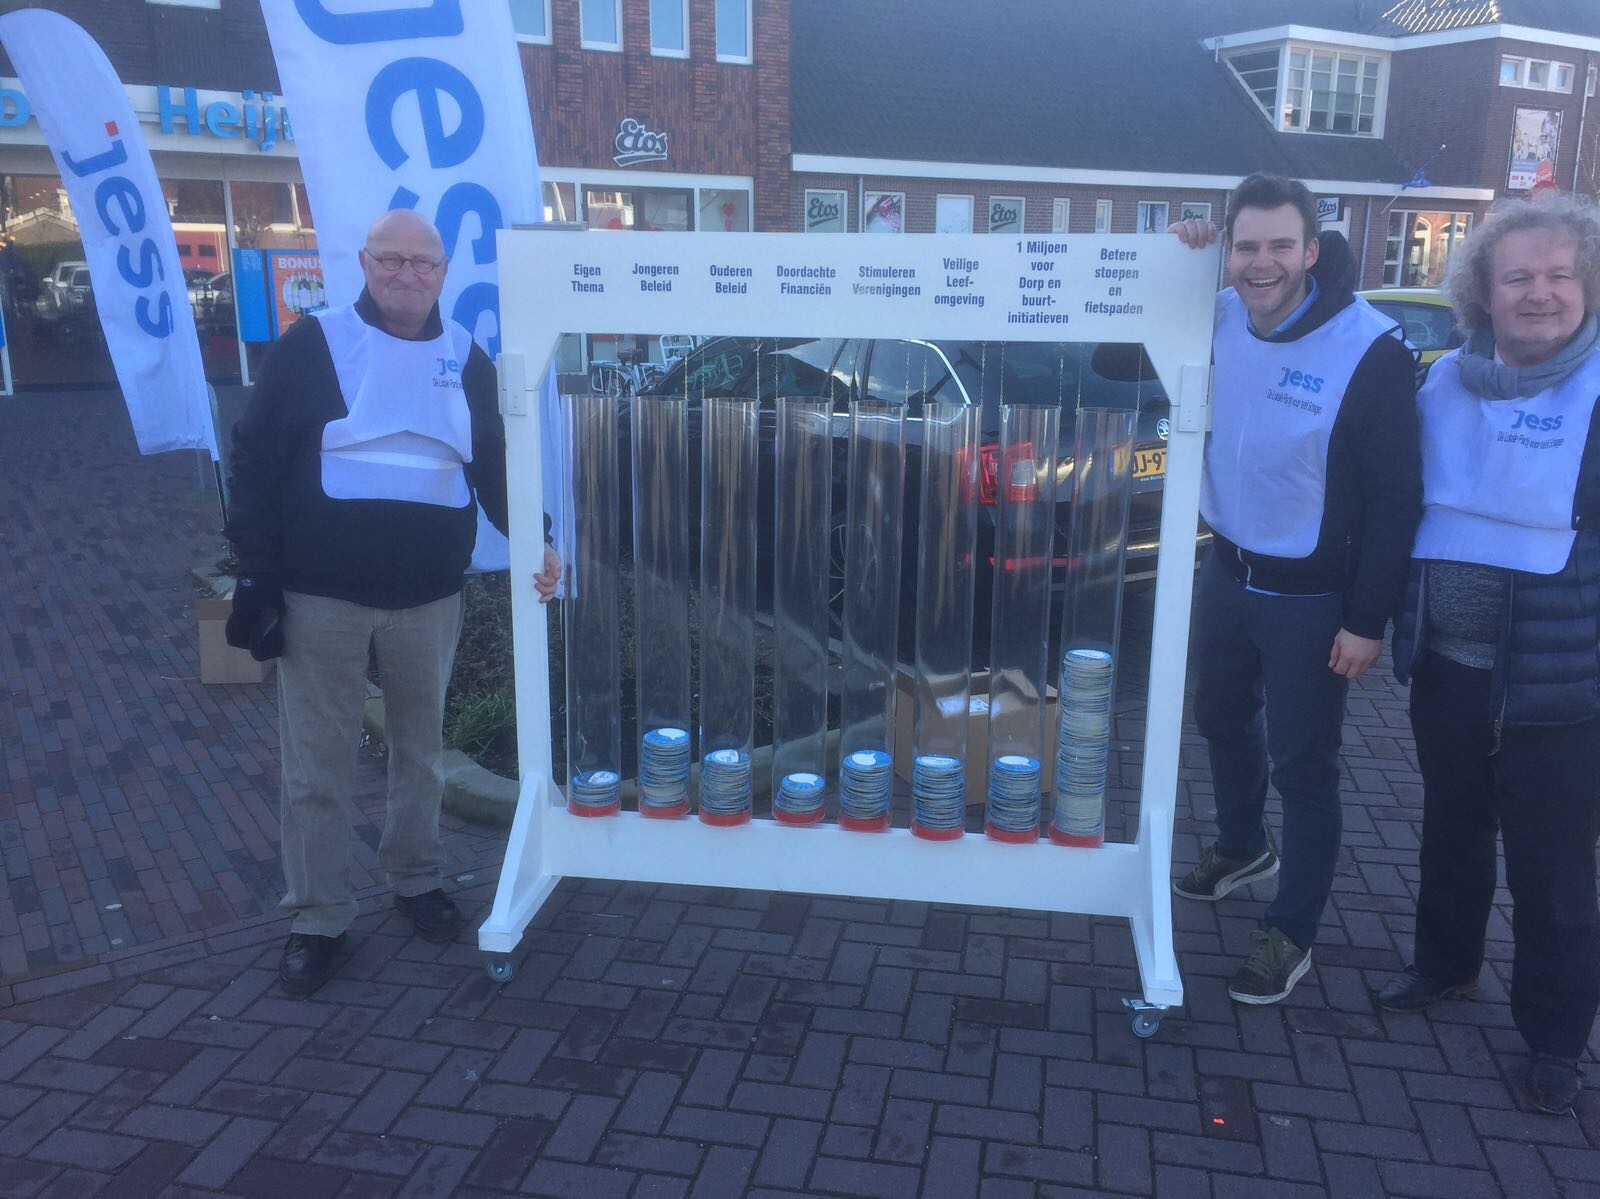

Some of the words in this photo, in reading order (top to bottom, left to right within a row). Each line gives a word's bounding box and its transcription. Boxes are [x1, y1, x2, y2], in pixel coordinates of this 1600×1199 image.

[613, 117, 668, 168] Etos
[807, 197, 840, 228] Etos
[1317, 200, 1337, 219] Etos
[990, 203, 1018, 232] Etos
[1016, 241, 1023, 253] 1
[1026, 241, 1068, 256] Miljoen
[1099, 248, 1137, 261] Betere
[573, 264, 601, 277] Eigen
[632, 263, 679, 277] Jongeren
[710, 265, 752, 278] Ouderen
[943, 258, 979, 273] Veilige
[1031, 262, 1055, 272] voor
[777, 266, 836, 279] Doordachte
[859, 266, 916, 279] Stimuleren
[1095, 267, 1139, 281] stoepen
[571, 281, 604, 293] Thema
[640, 280, 672, 292] Beleid
[715, 282, 747, 294] Beleid
[946, 275, 974, 288] Leef-
[1019, 277, 1045, 291] Dorp
[1047, 279, 1061, 289] en
[780, 282, 832, 295] Financiën
[852, 283, 921, 299] Verenigingen
[1108, 286, 1122, 296] en
[934, 293, 985, 308] omgeving
[1022, 294, 1056, 307] buurt-
[1084, 301, 1143, 316] fietspaden
[1007, 312, 1069, 324] initiatieven
[436, 357, 459, 376] Je
